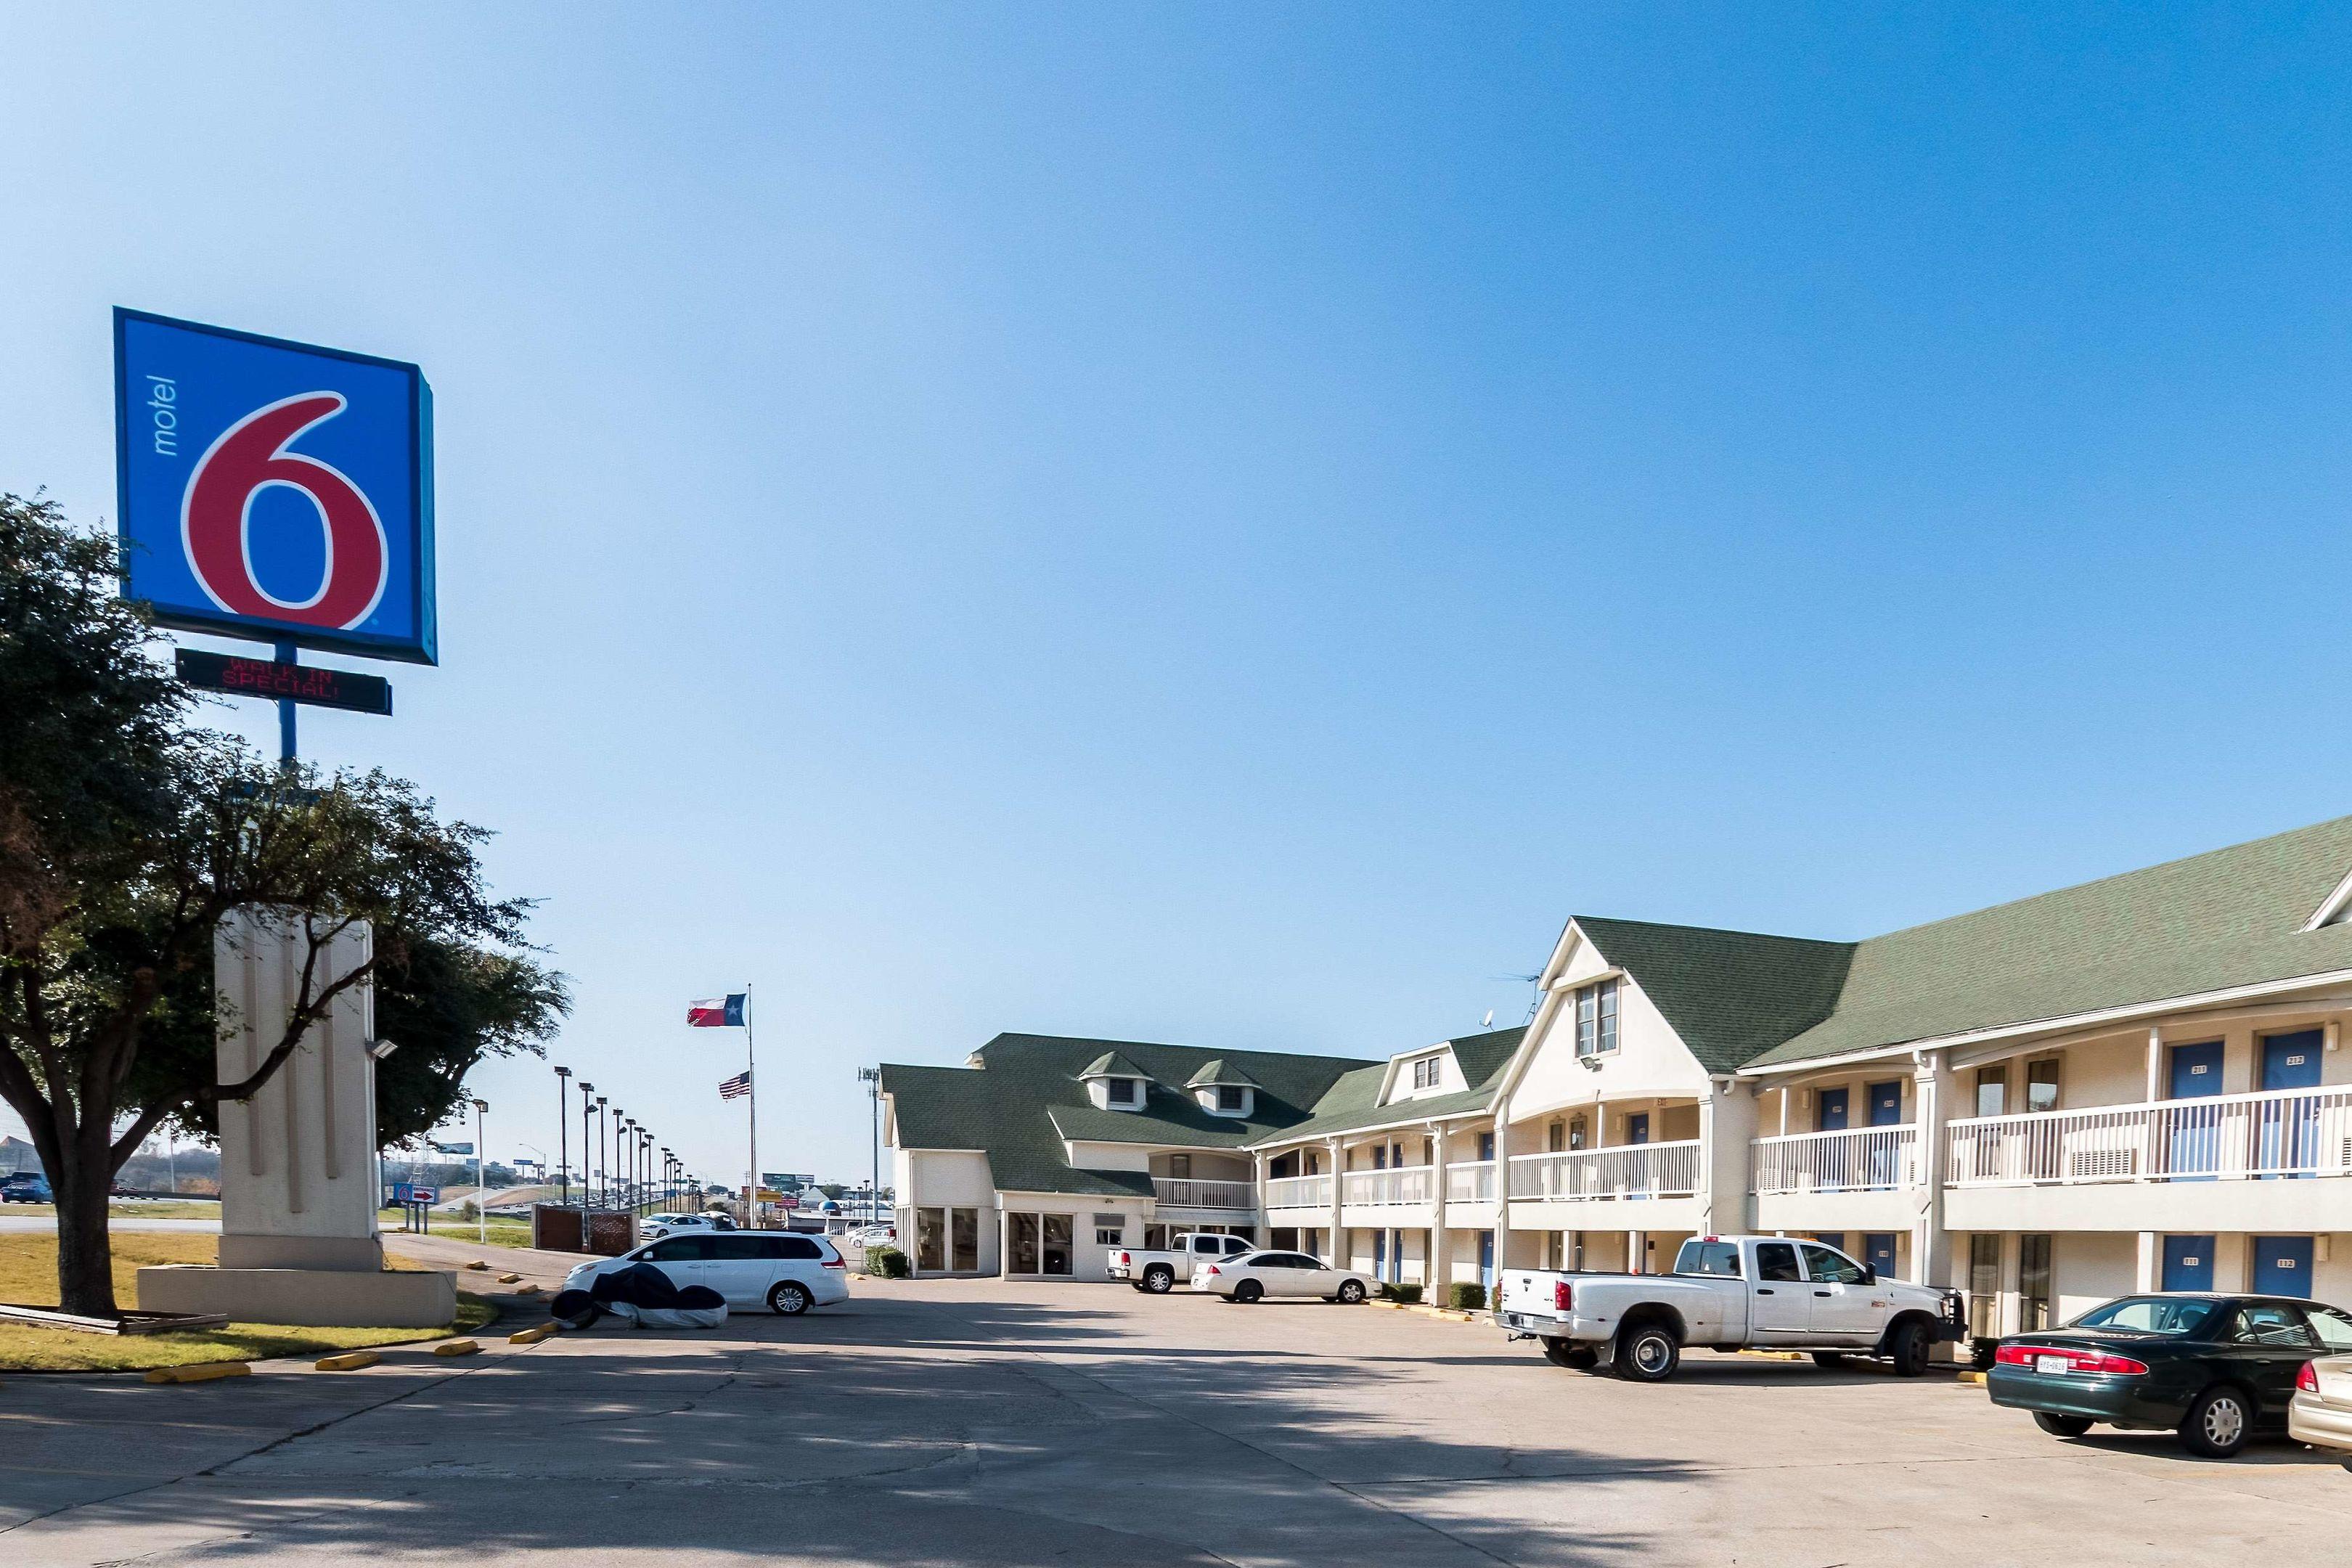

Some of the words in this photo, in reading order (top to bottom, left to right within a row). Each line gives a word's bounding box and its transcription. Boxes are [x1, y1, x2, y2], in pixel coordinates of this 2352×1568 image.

[147, 375, 176, 456] motel
[181, 391, 389, 630] 6
[229, 658, 297, 679] WALK
[309, 668, 332, 684] IN
[399, 1185, 411, 1201] 6
